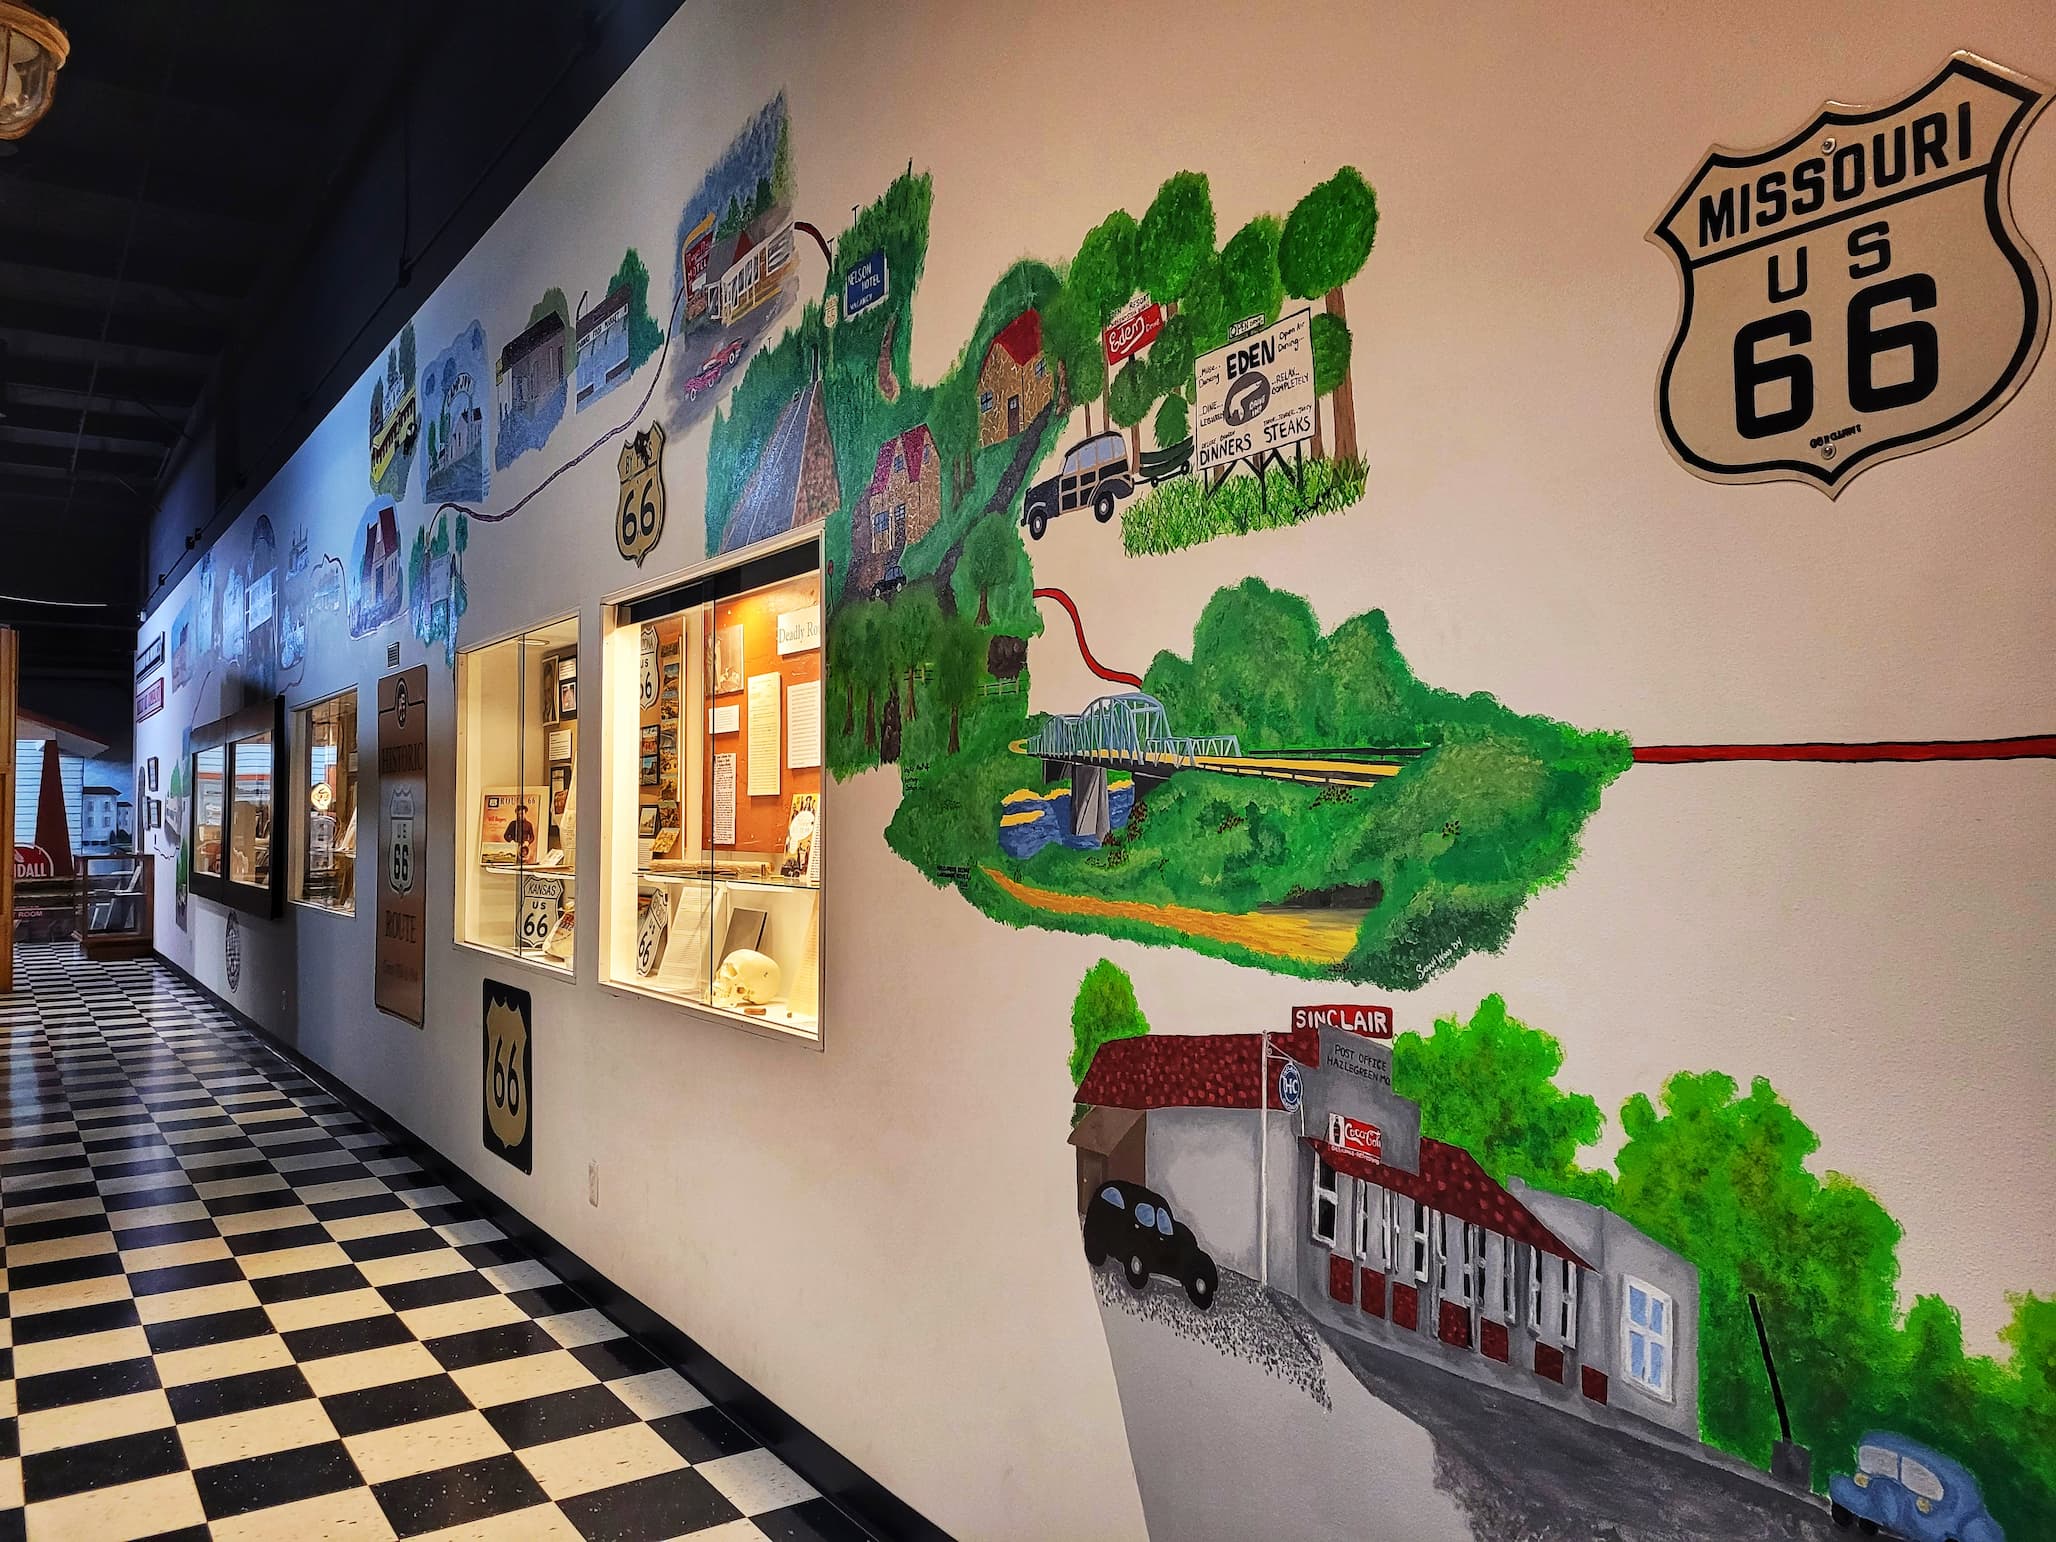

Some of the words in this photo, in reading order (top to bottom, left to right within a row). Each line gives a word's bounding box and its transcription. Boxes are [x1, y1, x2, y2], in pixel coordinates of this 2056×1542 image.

[1699, 101, 1971, 248] MISSOURI
[847, 261, 872, 286] NELSON
[1108, 315, 1146, 355] Eden
[1279, 327, 1296, 342] Open
[1226, 335, 1276, 380] EDEN
[1733, 273, 1939, 440] 66
[1271, 372, 1309, 395] COMPLETELY
[1263, 415, 1311, 444] STEAKS
[1200, 433, 1252, 467] DINNERS
[622, 477, 656, 546] 66
[778, 624, 805, 644] Deadly
[381, 742, 424, 775] HISTORIC
[393, 844, 410, 882] 66
[527, 884, 558, 897] KANSAS
[18, 910, 43, 918] ROOM
[532, 901, 546, 910] US
[385, 910, 417, 944] ROUTE
[523, 913, 548, 938] 66
[638, 931, 652, 967] 66
[1296, 1009, 1388, 1034] SINCLAIR
[1326, 1055, 1379, 1081] HAZLEGREEN
[1334, 1044, 1356, 1061] POST
[1358, 1053, 1388, 1072] OFFICE
[493, 1033, 520, 1117] 66
